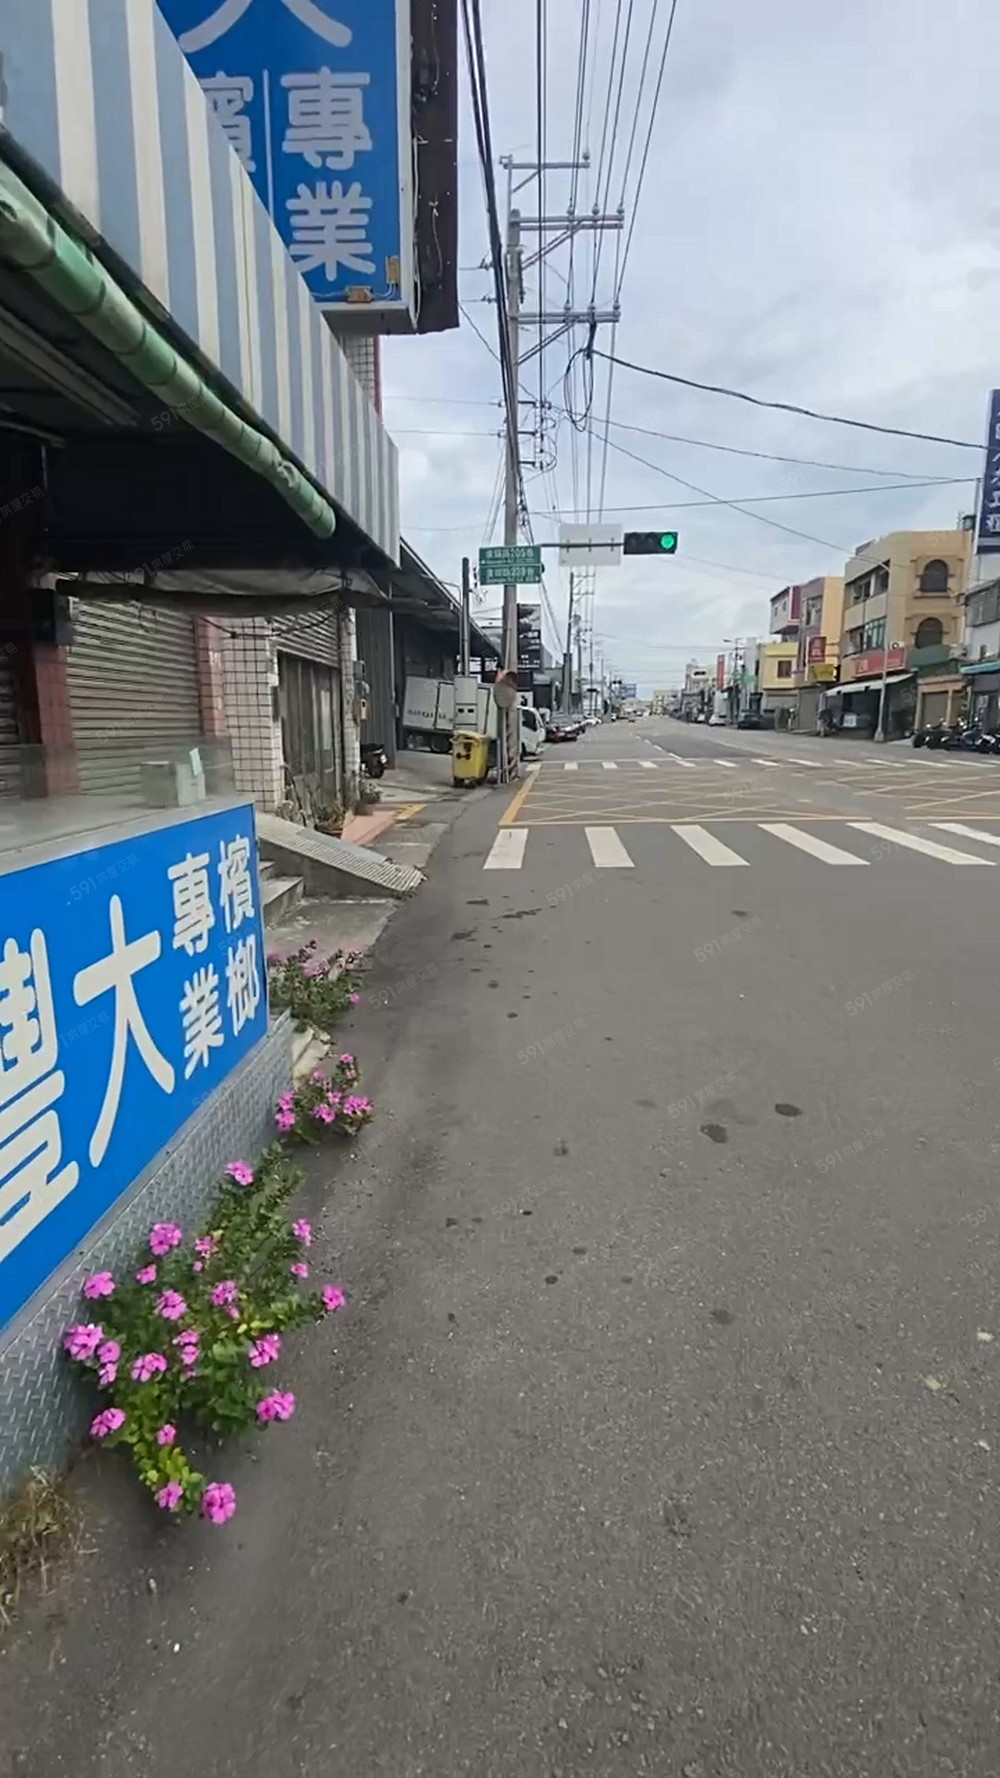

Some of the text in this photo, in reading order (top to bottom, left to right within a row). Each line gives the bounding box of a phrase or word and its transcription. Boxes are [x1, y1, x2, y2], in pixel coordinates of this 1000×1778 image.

[279, 66, 376, 281] 專業
[167, 851, 225, 1080] 專業
[217, 834, 262, 1037] 檳榔
